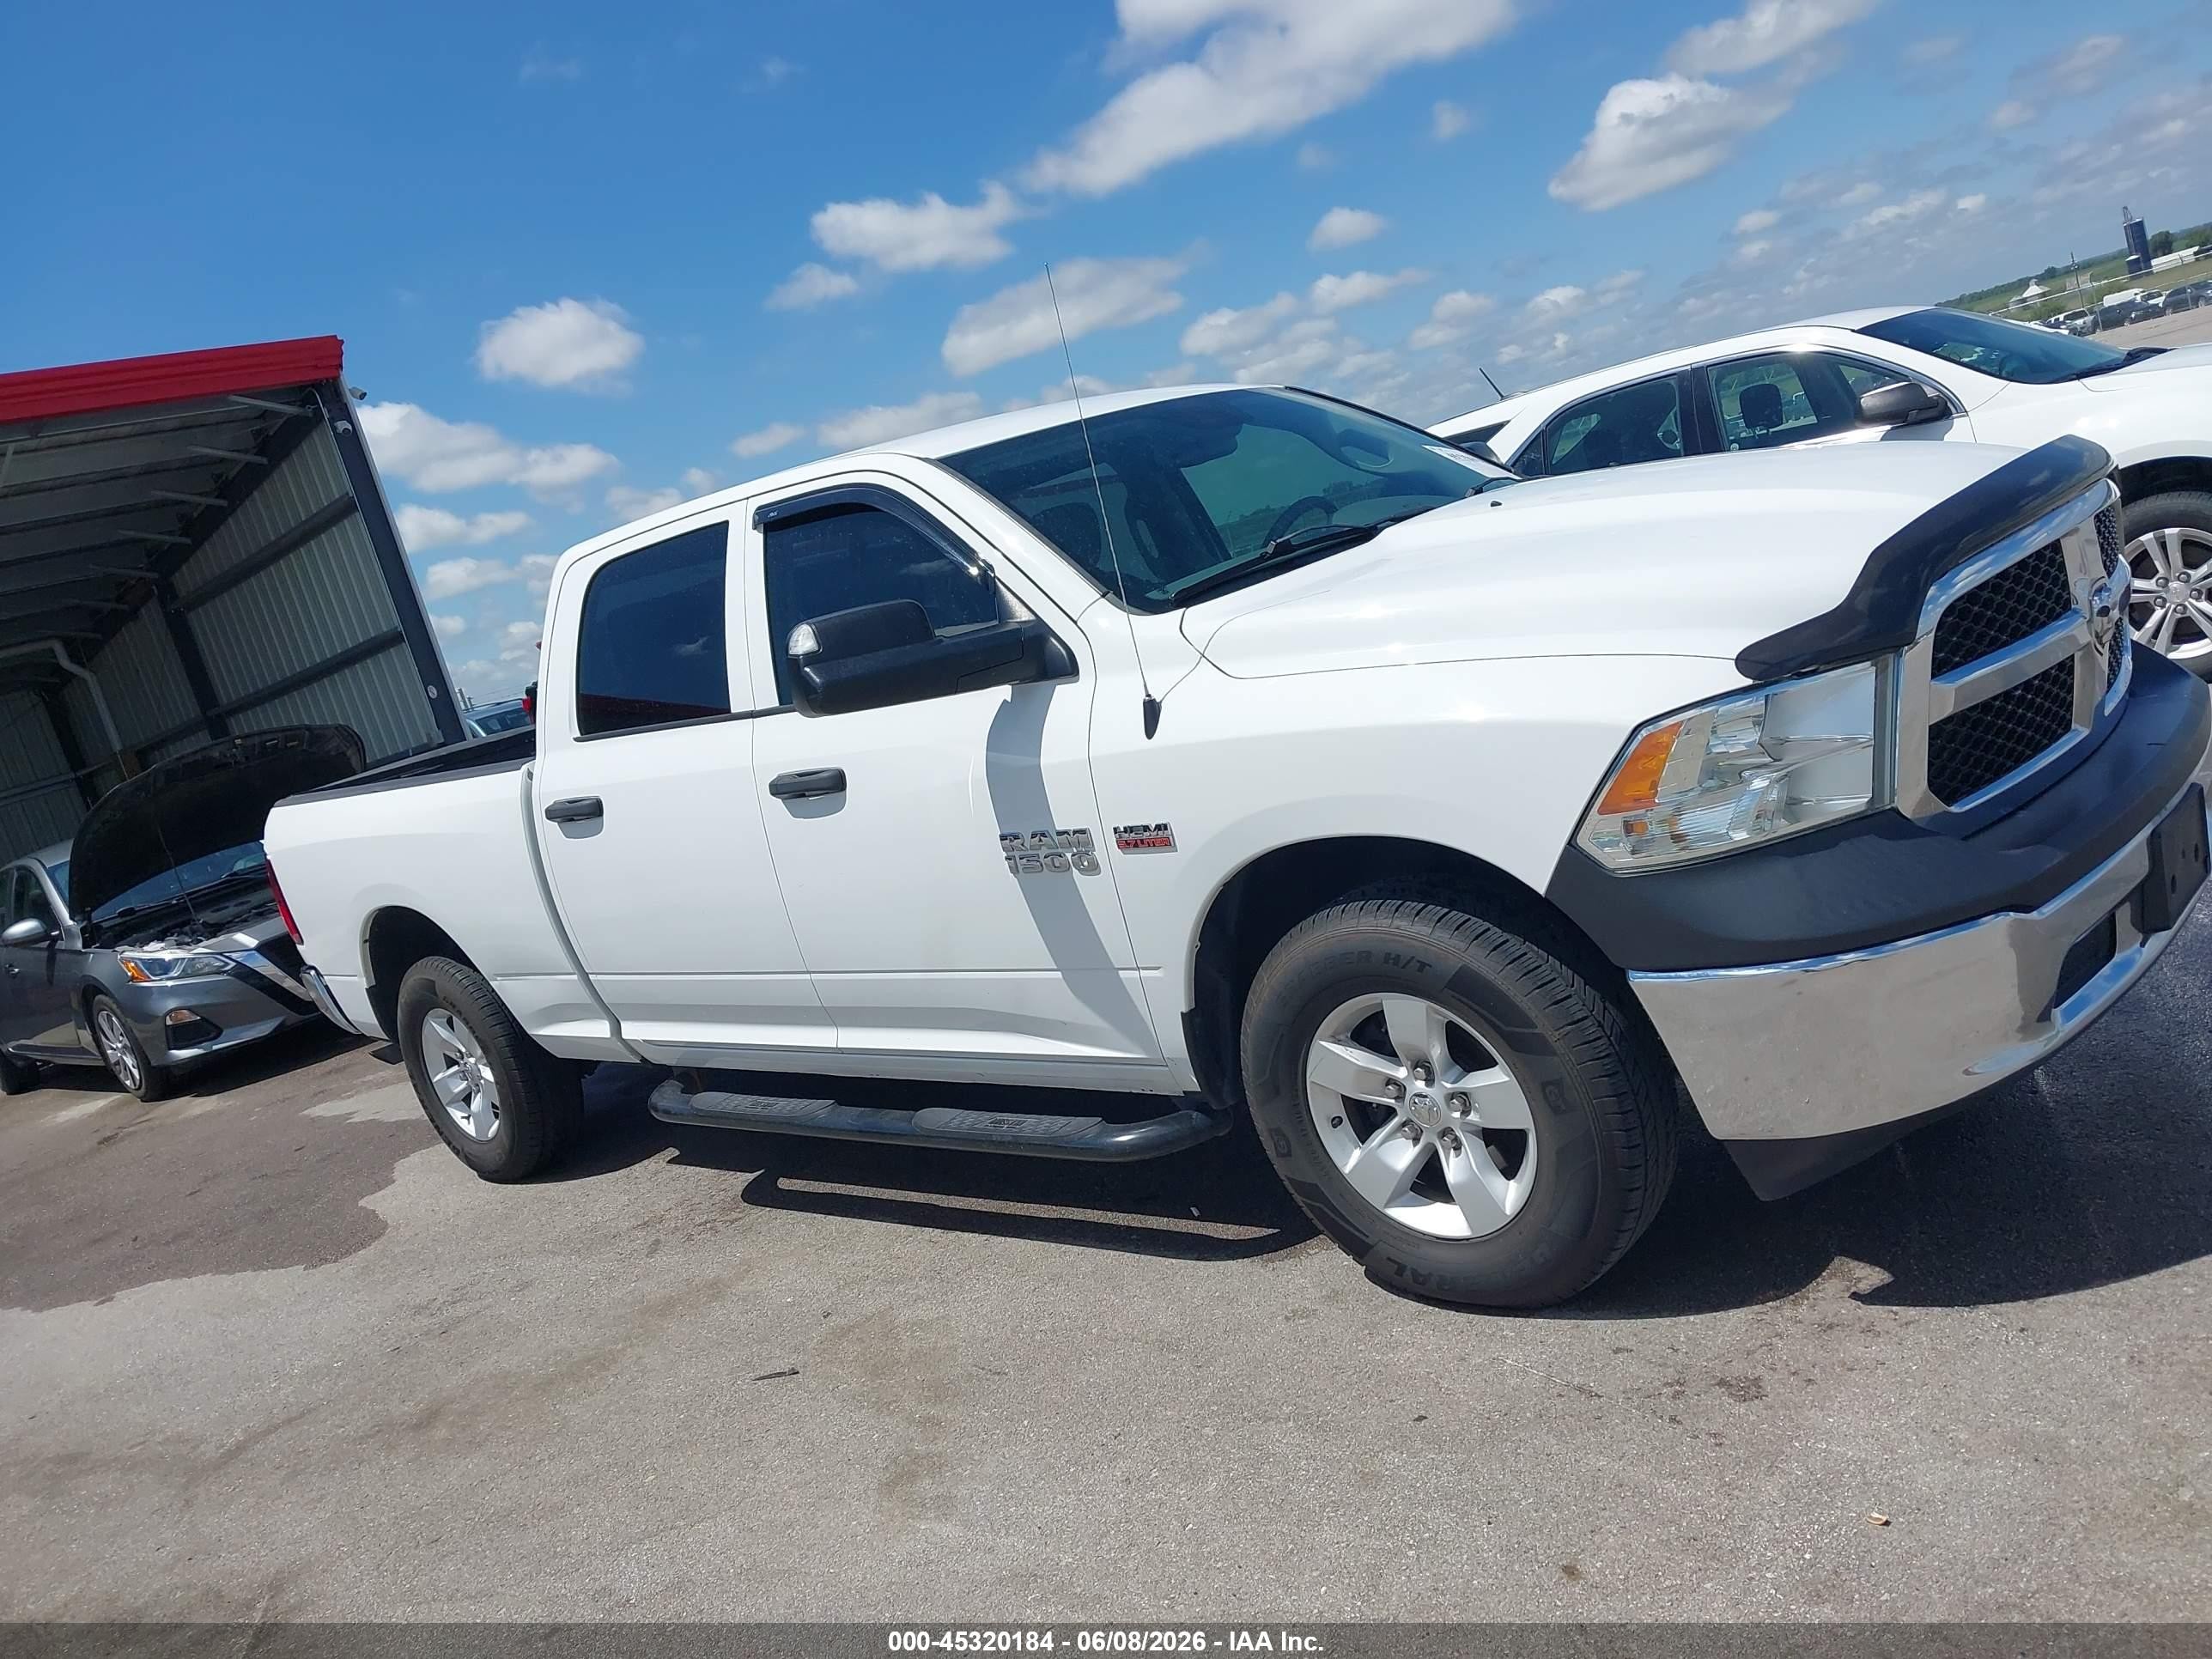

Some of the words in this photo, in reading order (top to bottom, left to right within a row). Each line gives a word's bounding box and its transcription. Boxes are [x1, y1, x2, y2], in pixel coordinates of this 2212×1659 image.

[1000, 828, 1096, 853] RAM
[1113, 823, 1172, 838] HEMI
[1117, 839, 1134, 848] 5.7
[1137, 837, 1170, 848] LITER
[1005, 852, 1101, 876] 1500
[1383, 952, 1432, 973] H/T
